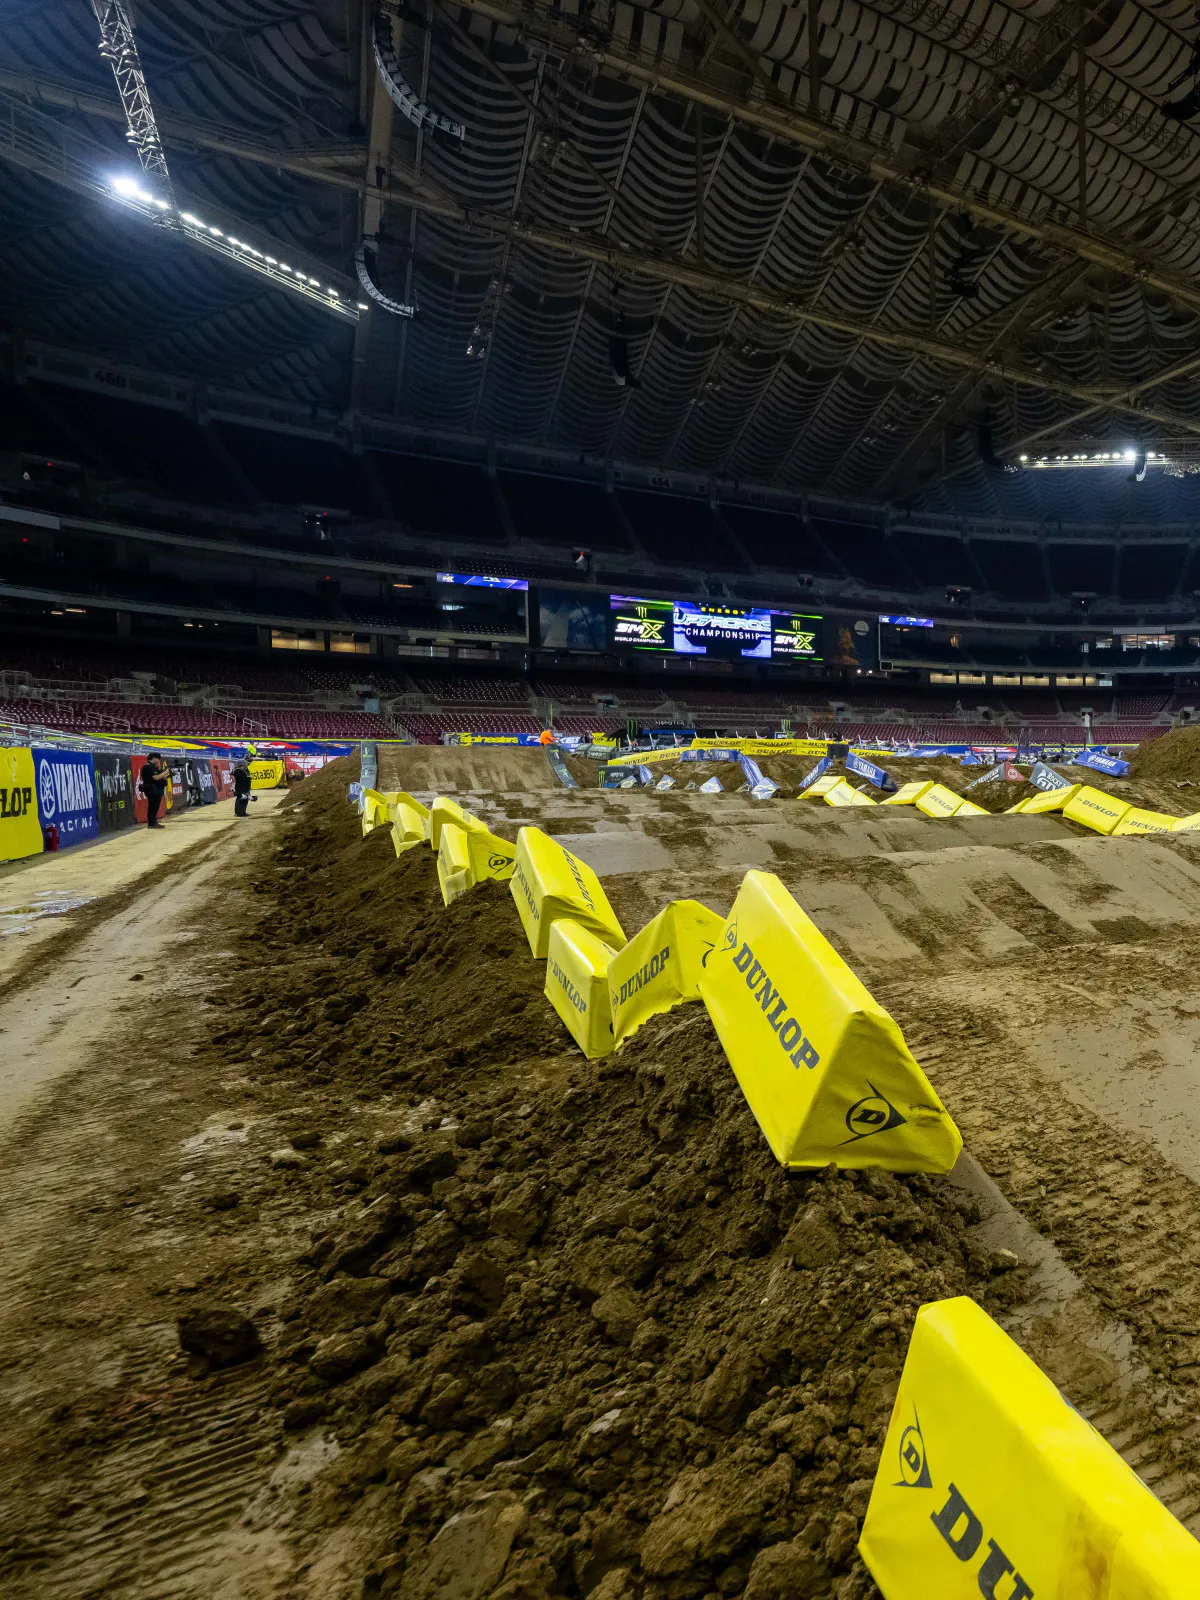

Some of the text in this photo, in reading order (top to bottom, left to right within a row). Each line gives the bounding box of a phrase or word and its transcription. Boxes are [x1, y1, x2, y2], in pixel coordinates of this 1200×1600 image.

[615, 622, 663, 640] SMX
[685, 627, 761, 641] CHAMPIONSHIP
[774, 634, 813, 650] SMX
[624, 756, 650, 766] DUNLOP
[1097, 756, 1117, 767] YAMAHA
[858, 762, 876, 779] YAMAHA
[52, 763, 94, 813] YAMAHA
[1082, 799, 1119, 818] DUNLOP
[1129, 820, 1169, 833] DUNLOP
[619, 946, 670, 1006] DUNLOP
[552, 961, 587, 1015] DUNLOP
[732, 942, 821, 1070] DUNLOP
